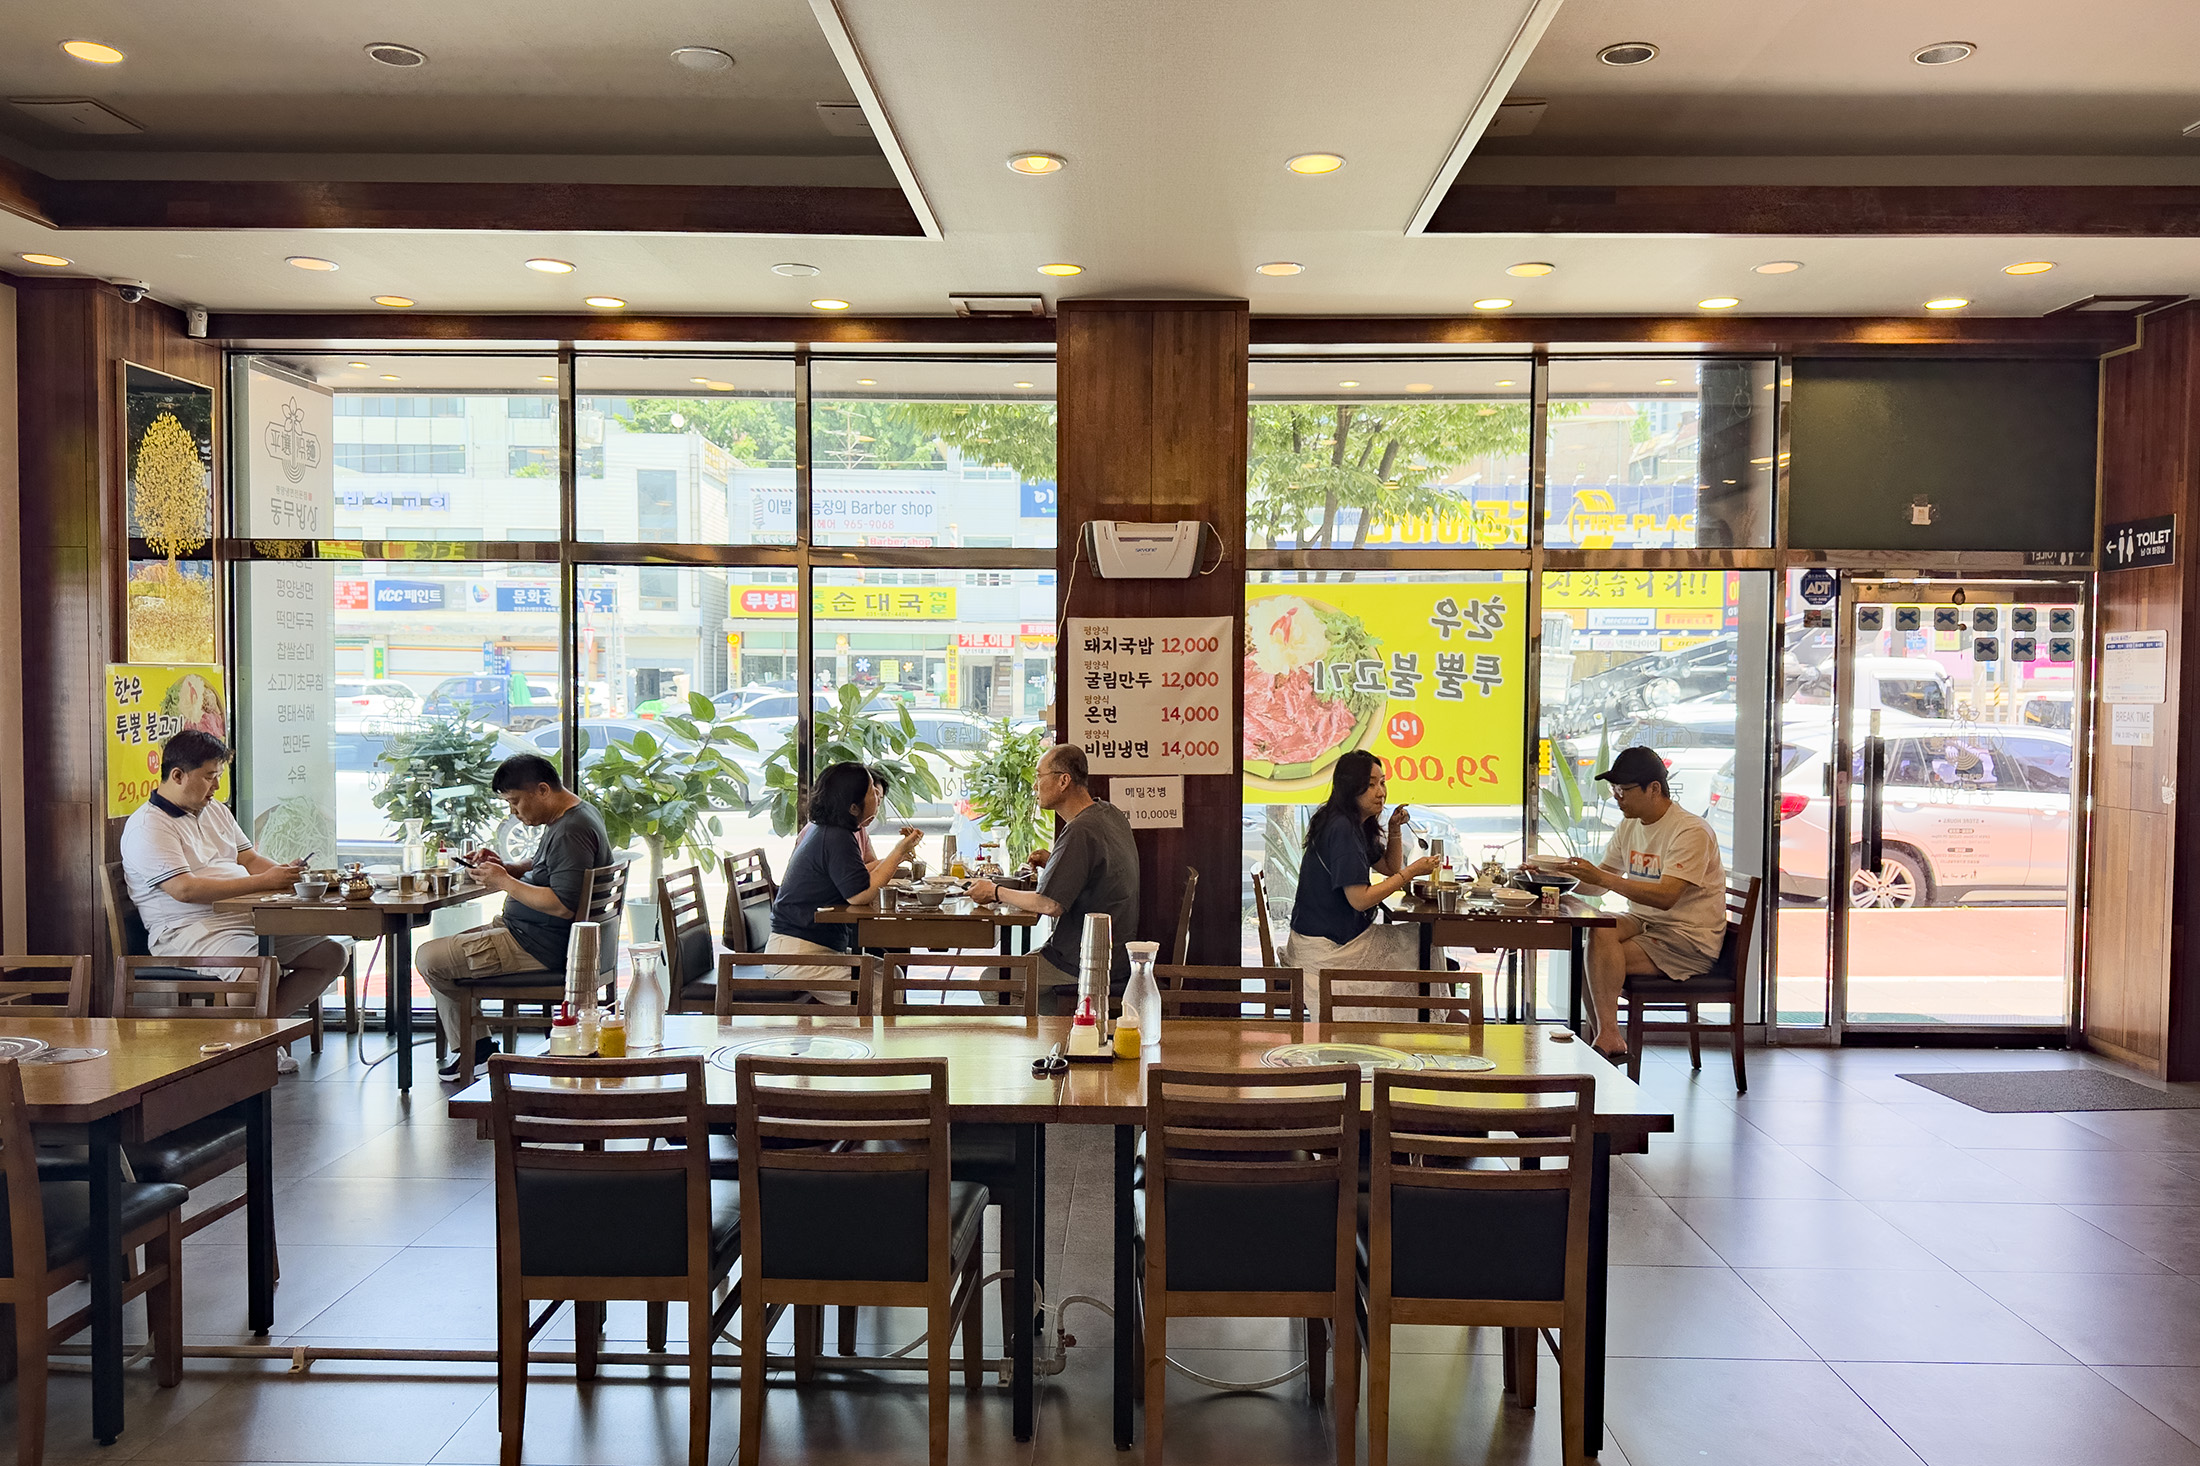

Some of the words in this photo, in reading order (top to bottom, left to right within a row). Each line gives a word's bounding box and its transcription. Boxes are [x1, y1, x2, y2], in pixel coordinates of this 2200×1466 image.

[270, 498, 318, 532] 동무밥상
[851, 501, 896, 515] Barber
[902, 502, 933, 517] shop
[844, 519, 895, 530] 965-9068
[1574, 514, 1628, 532] TIRE
[2136, 529, 2171, 546] TOILET
[276, 579, 314, 600] 평양냉면
[377, 588, 403, 602] KCC
[404, 589, 442, 603] 페인트
[1804, 581, 1831, 595] ADT
[746, 592, 796, 609] 무봉리
[276, 610, 314, 630] 떡만두국
[1605, 617, 1649, 626] MICHELIN
[1665, 614, 1714, 625] PIRELLI
[1083, 626, 1109, 636] 평양식
[277, 642, 315, 661] 찹쌀순대
[1084, 637, 1155, 655] 돼지국밥
[1161, 637, 1219, 656] 12,000
[1084, 660, 1109, 670] 평양식
[113, 675, 143, 704] 한우
[267, 673, 324, 692] 소고기초무침
[1084, 671, 1152, 689] 굴림만두
[1161, 671, 1219, 691] 12,000
[1084, 695, 1109, 705] 평양식
[277, 704, 315, 723] 명태식해
[1084, 705, 1117, 723] 온면
[1161, 706, 1219, 725] 14,000
[2115, 711, 2135, 722] BREAK
[2136, 712, 2150, 722] TIME
[115, 713, 142, 743] 투뿔
[145, 712, 184, 742] 불고기
[1084, 729, 1109, 739] 평양식
[283, 735, 311, 753] 찐만두
[1085, 740, 1150, 758] 비빔냉면
[1161, 741, 1219, 759] 14,000
[148, 756, 160, 769] 1인
[288, 765, 306, 784] 수육
[1125, 787, 1166, 798] 메밀전병
[1135, 808, 1177, 820] 10,000원
